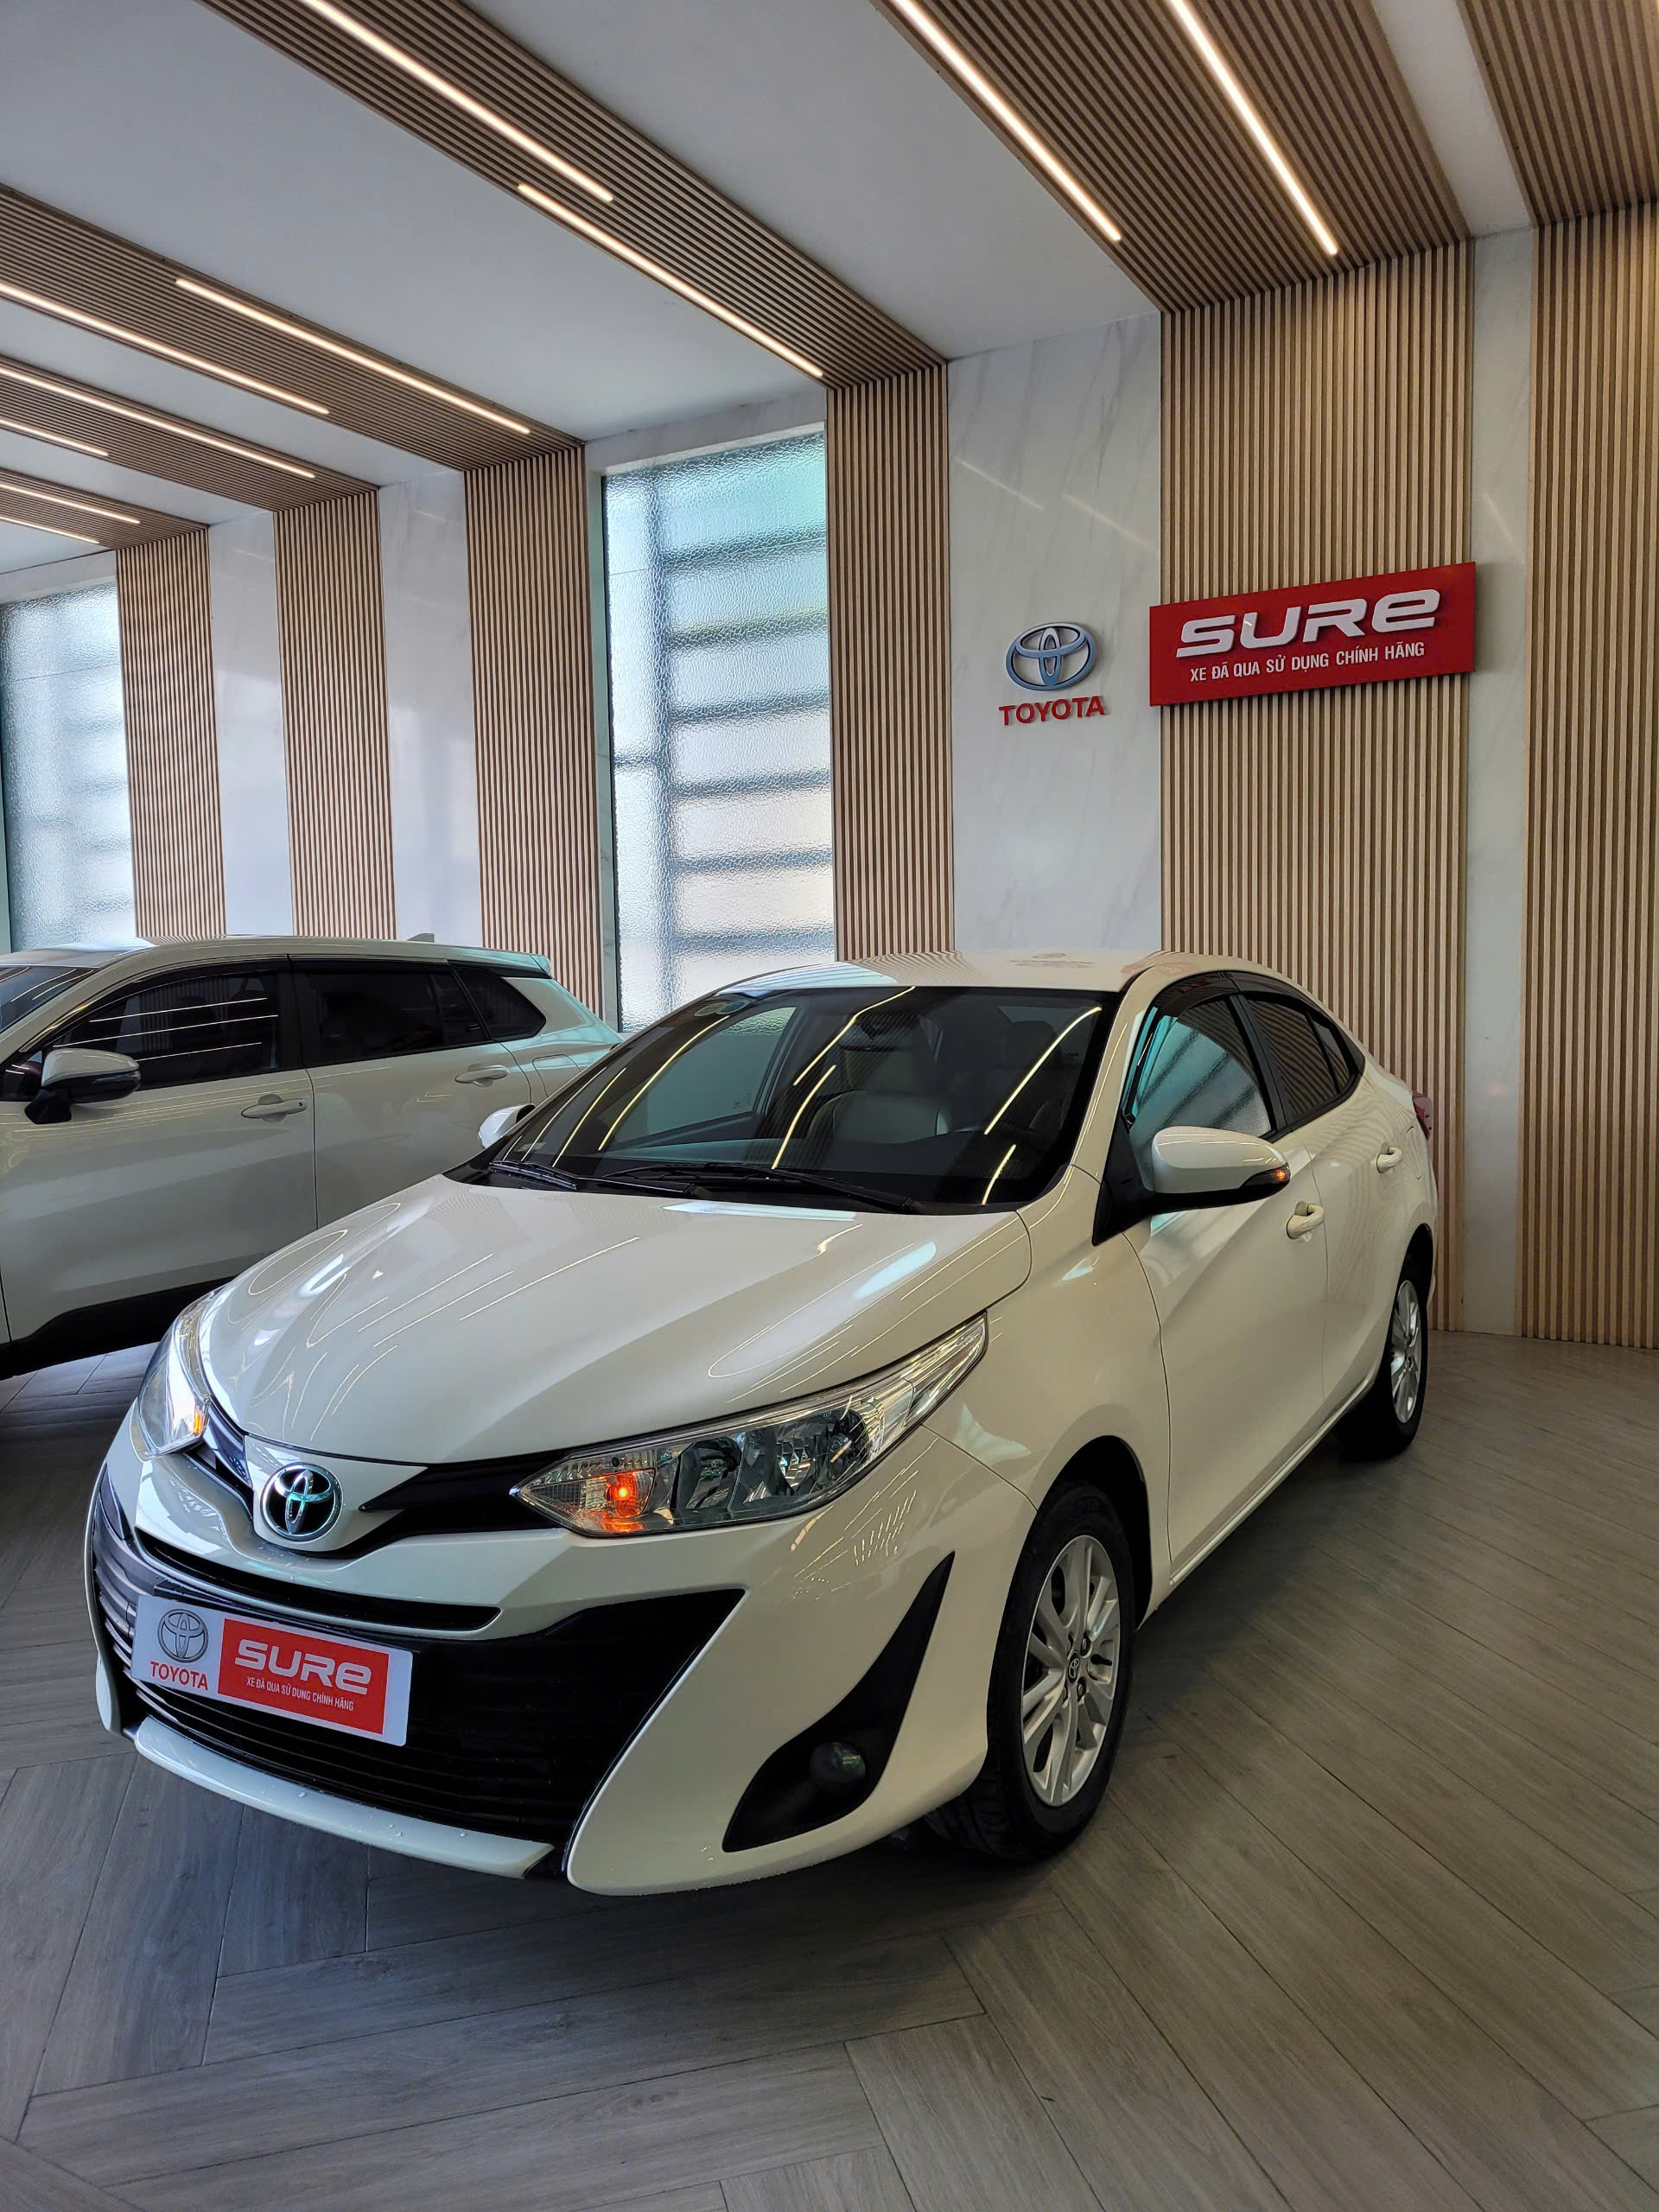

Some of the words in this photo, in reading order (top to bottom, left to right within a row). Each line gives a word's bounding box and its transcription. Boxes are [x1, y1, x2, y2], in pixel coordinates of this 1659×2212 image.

[1190, 667, 1207, 683] XE
[1211, 661, 1230, 680] ĐÃ
[1233, 661, 1261, 678] QUA
[1266, 654, 1286, 673] SỬ
[1292, 652, 1330, 673] DỤNG
[1336, 645, 1379, 666] CHÍNH
[1384, 640, 1426, 660] HÃNG
[999, 696, 1106, 726] TOYOTA
[149, 1660, 209, 1691] TOYOTA
[246, 1675, 256, 1688] XE
[266, 1681, 281, 1693] QUA
[281, 1683, 292, 1696] SỬ
[292, 1687, 311, 1701] DỤNG
[312, 1691, 334, 1707] CHÍNH
[334, 1697, 354, 1712] HÃNG
